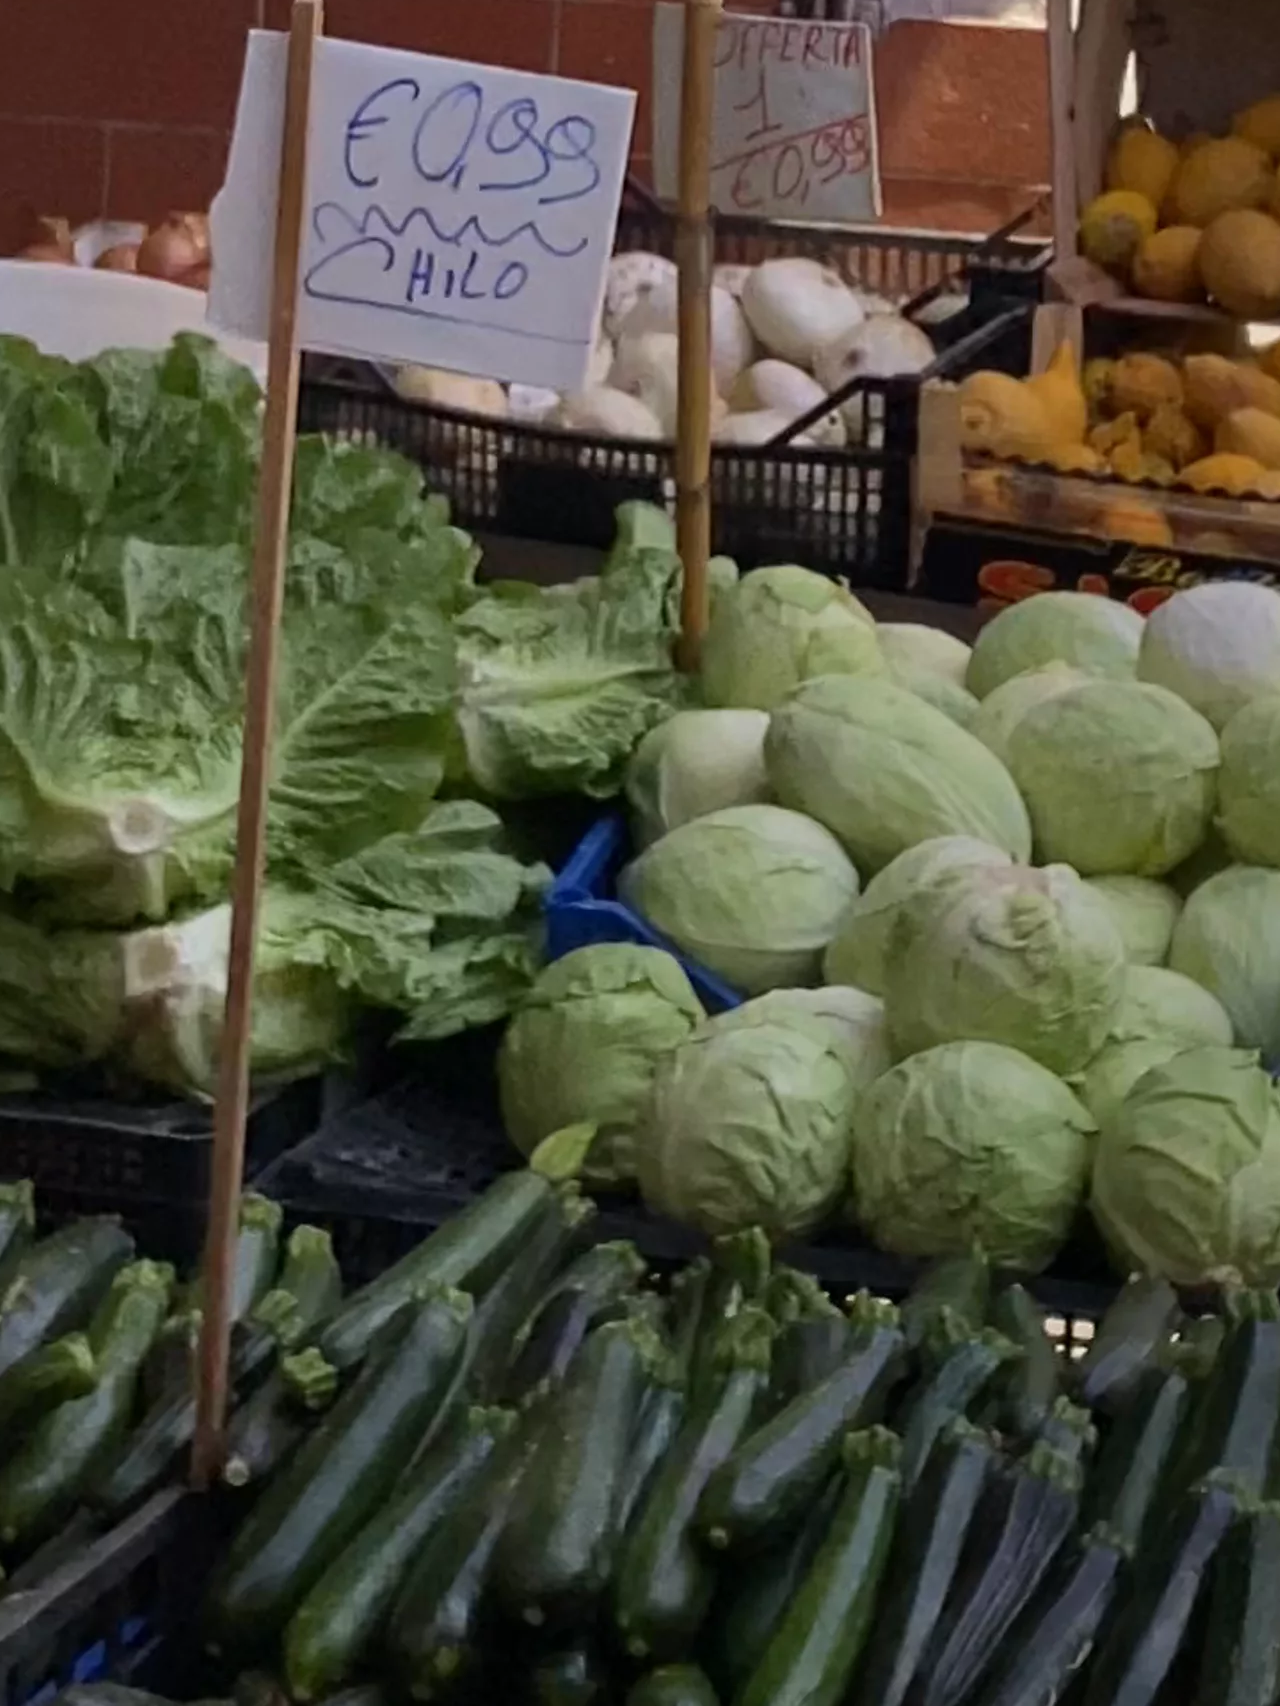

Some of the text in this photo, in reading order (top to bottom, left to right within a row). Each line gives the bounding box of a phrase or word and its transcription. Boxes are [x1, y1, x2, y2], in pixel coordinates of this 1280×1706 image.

[344, 77, 600, 204] €0,99
[732, 66, 783, 143] 1
[303, 236, 529, 303] CHILO
